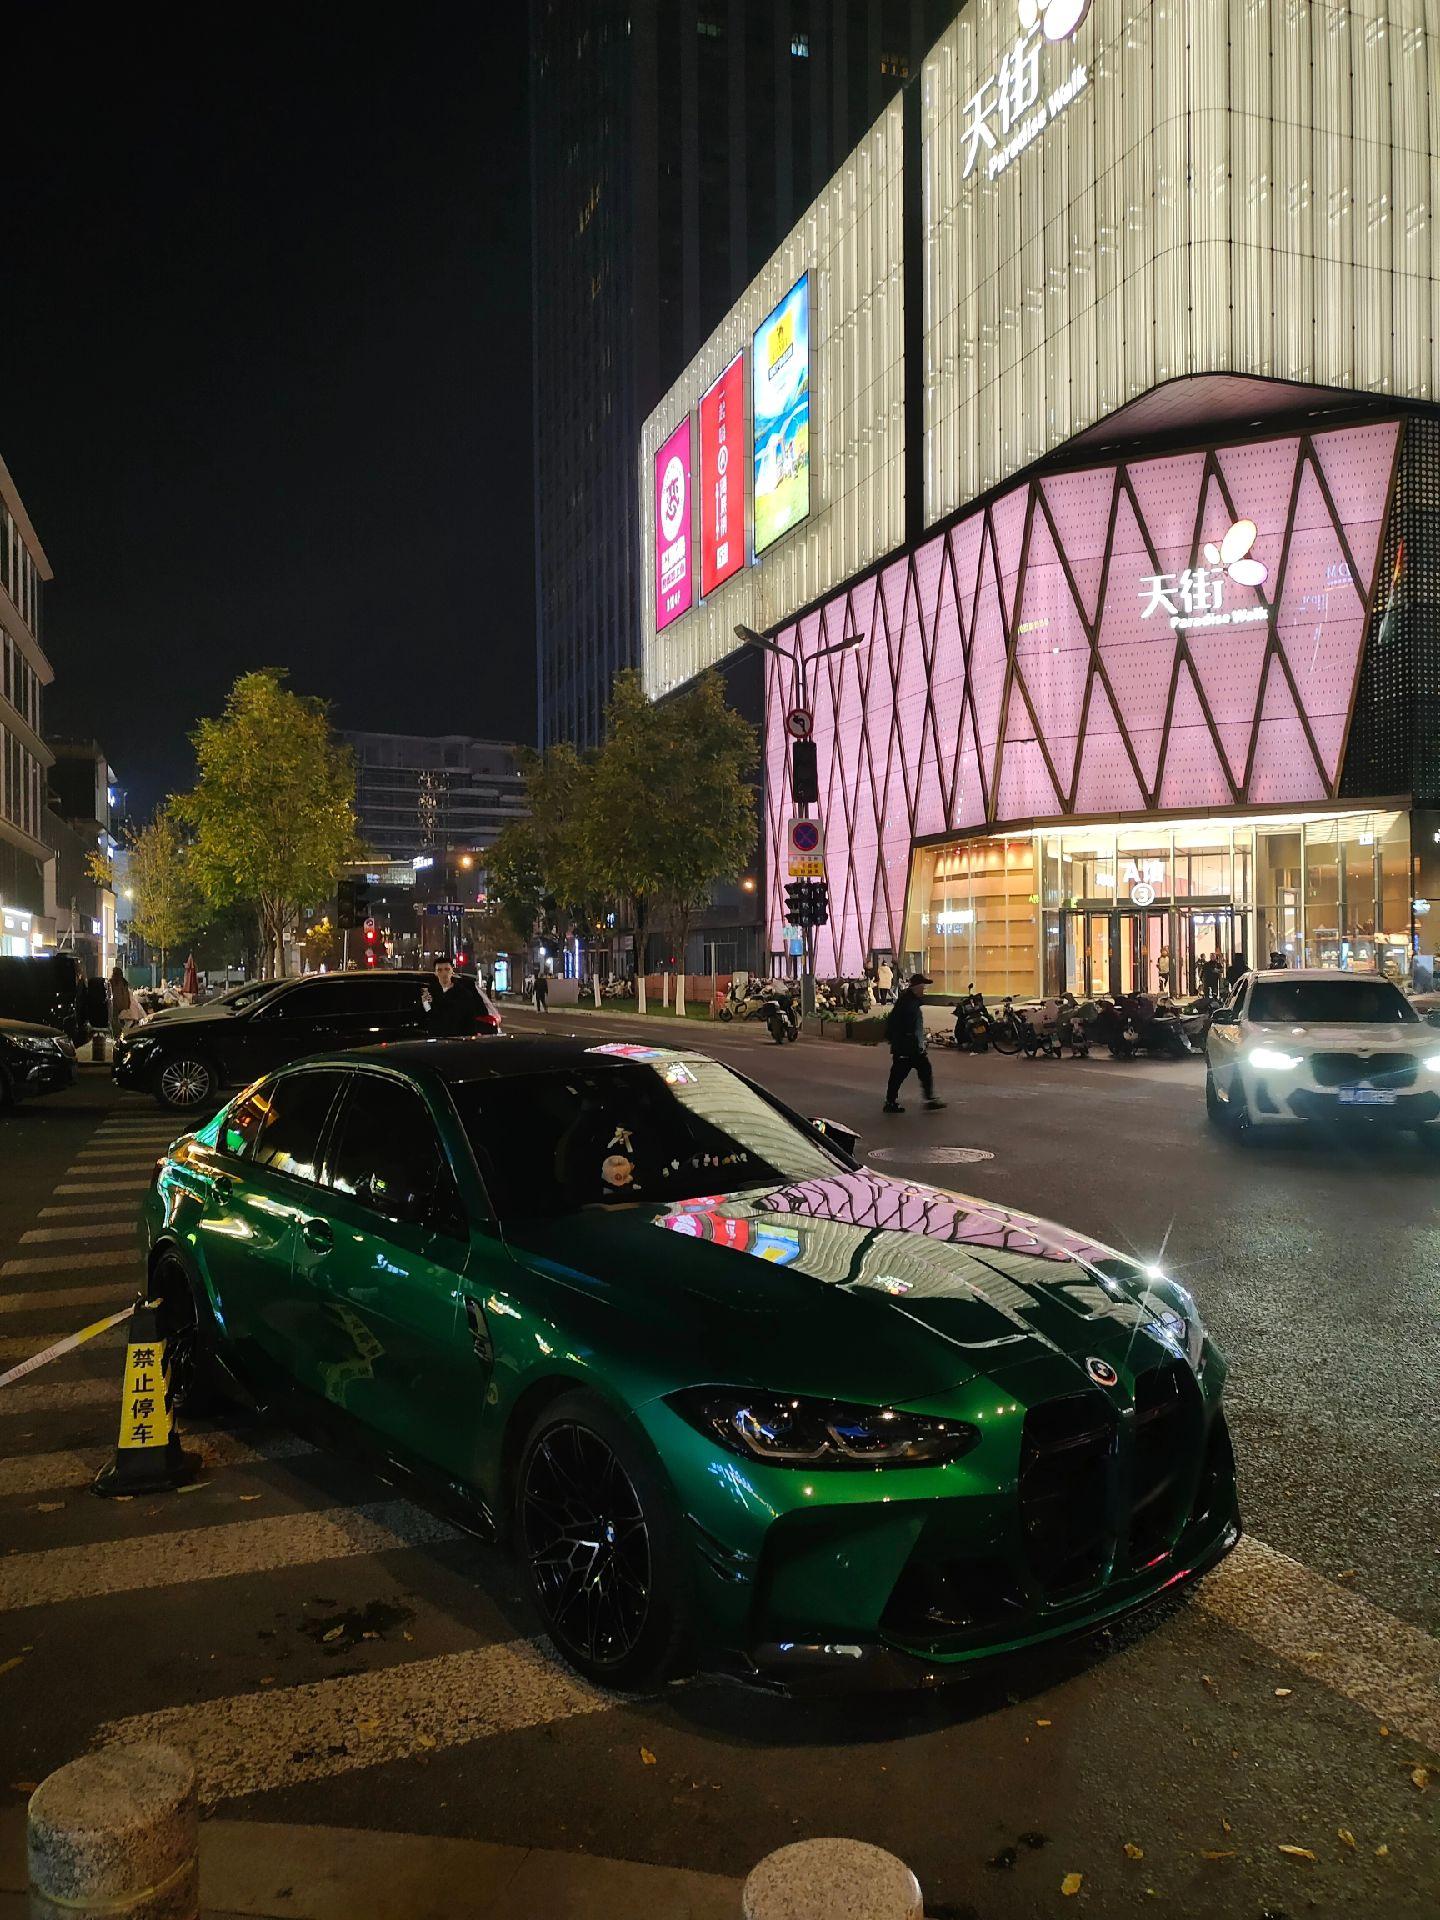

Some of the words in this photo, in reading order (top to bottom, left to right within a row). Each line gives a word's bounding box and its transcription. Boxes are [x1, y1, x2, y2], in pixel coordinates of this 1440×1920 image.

[960, 19, 1043, 180] 天街
[988, 107, 1047, 181] Paradise
[1048, 64, 1089, 118] Walk
[1137, 567, 1225, 619] 天街
[1170, 612, 1231, 629] Paradise
[1231, 607, 1269, 624] Walk
[131, 1348, 155, 1444] 禁止停车
